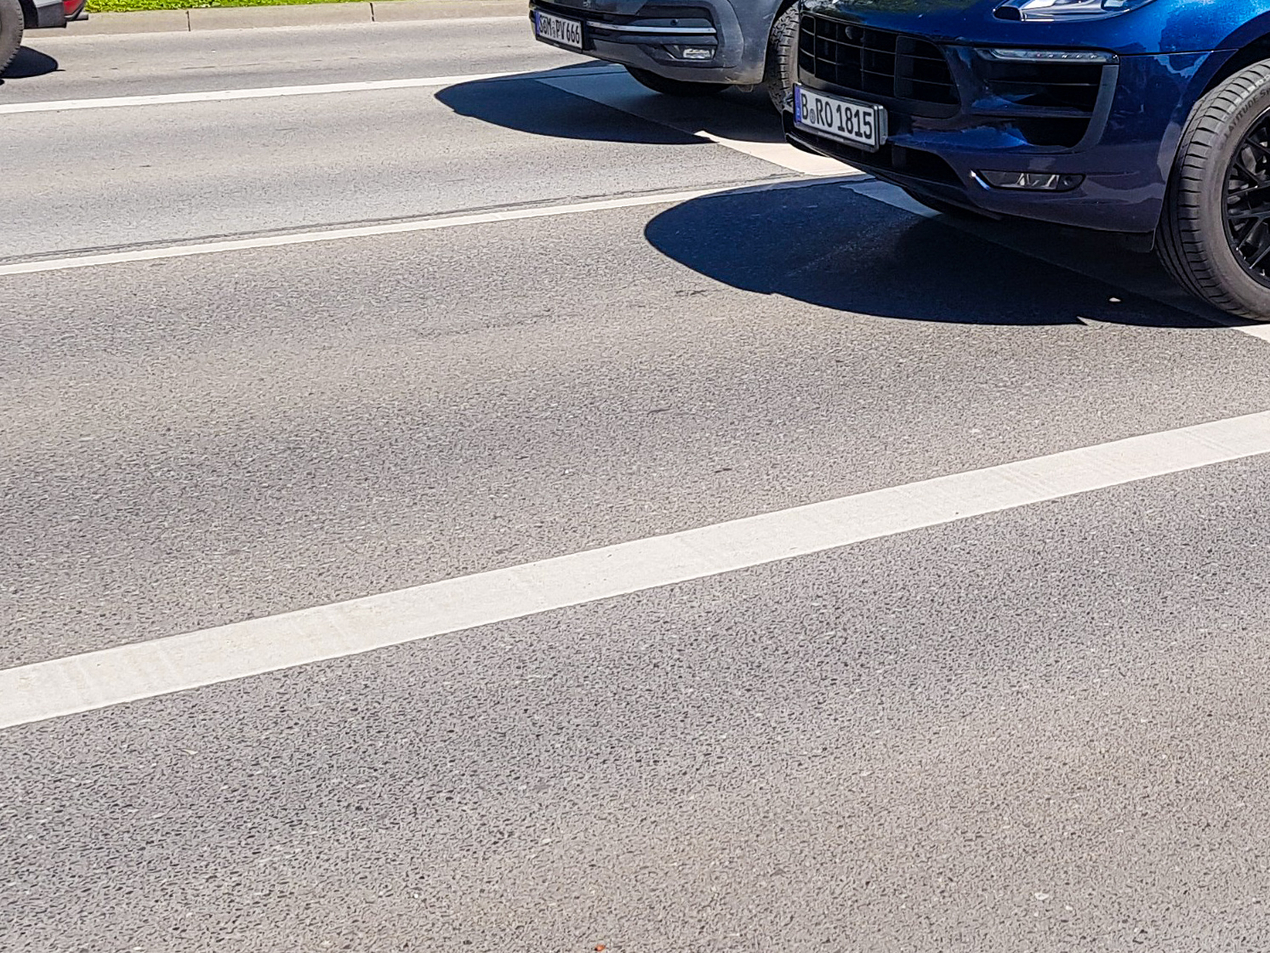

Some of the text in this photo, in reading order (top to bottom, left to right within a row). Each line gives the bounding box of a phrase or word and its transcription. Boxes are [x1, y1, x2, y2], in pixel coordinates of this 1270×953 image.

[566, 22, 580, 44] 666
[801, 93, 873, 140] B RO 1815
